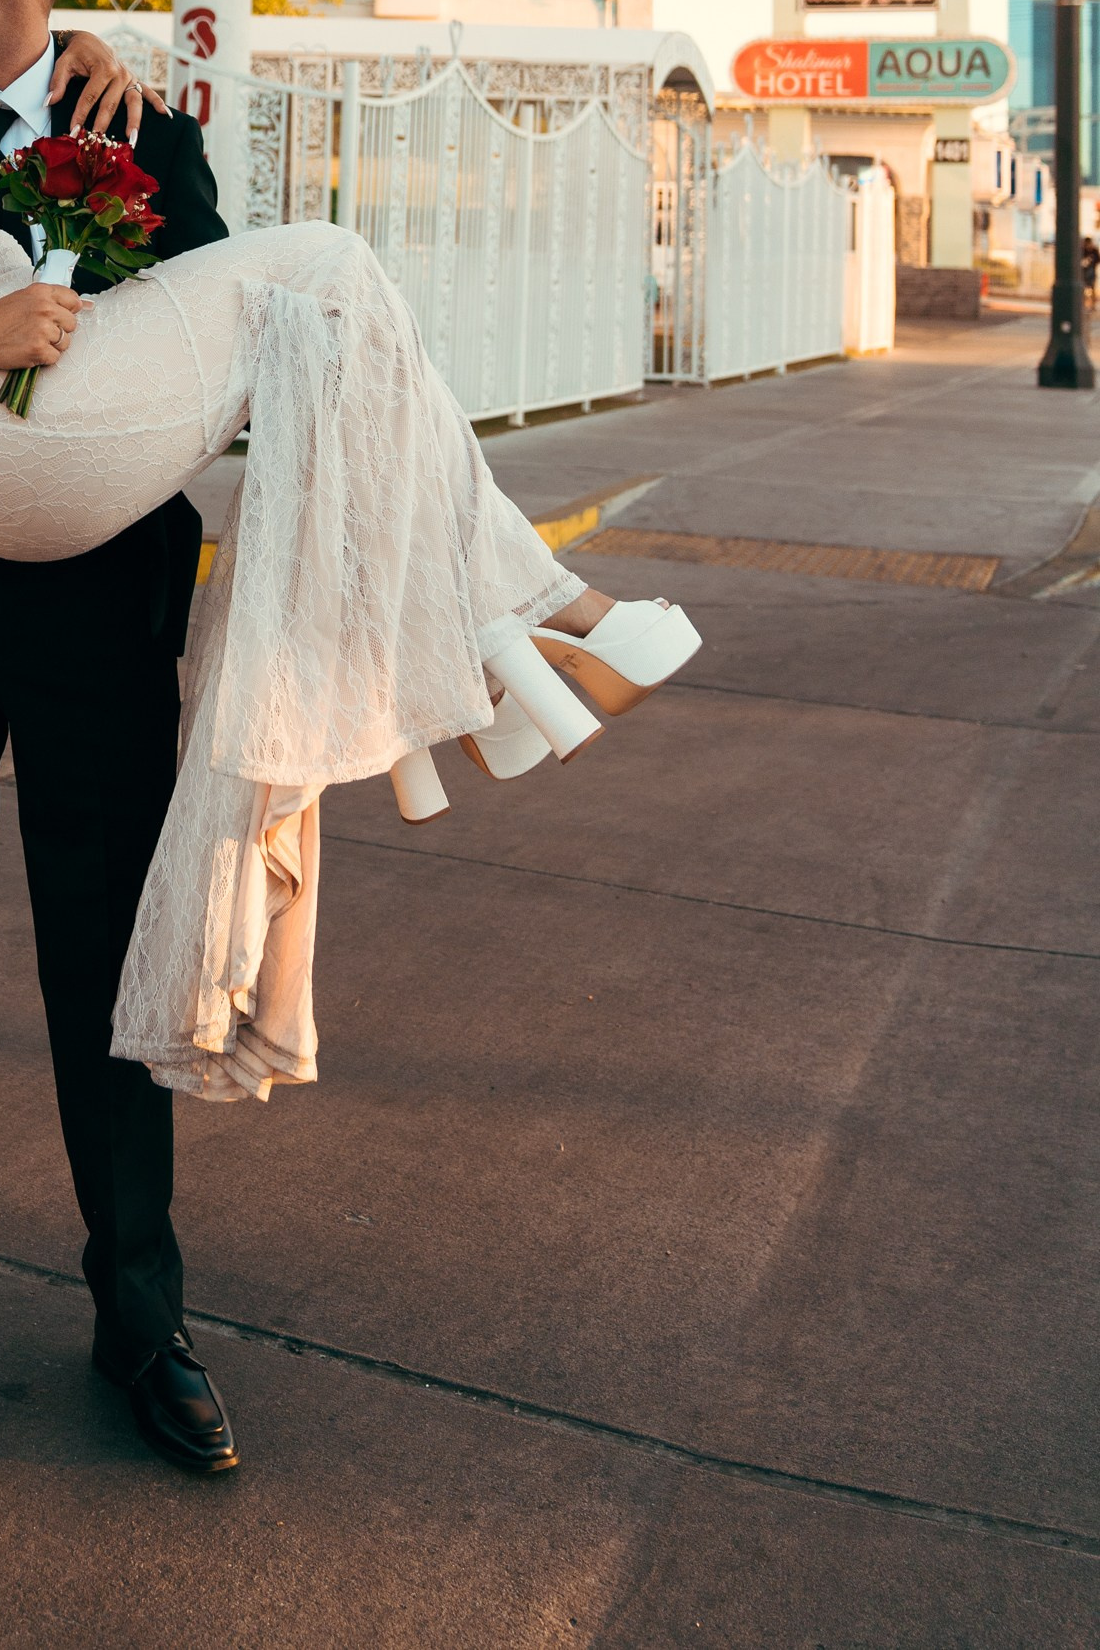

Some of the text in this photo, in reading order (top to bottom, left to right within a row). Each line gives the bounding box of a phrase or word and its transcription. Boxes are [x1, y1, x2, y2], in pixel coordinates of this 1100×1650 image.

[754, 44, 852, 74] Shalimar
[876, 47, 992, 80] AQUA
[753, 71, 852, 96] HOTEL
